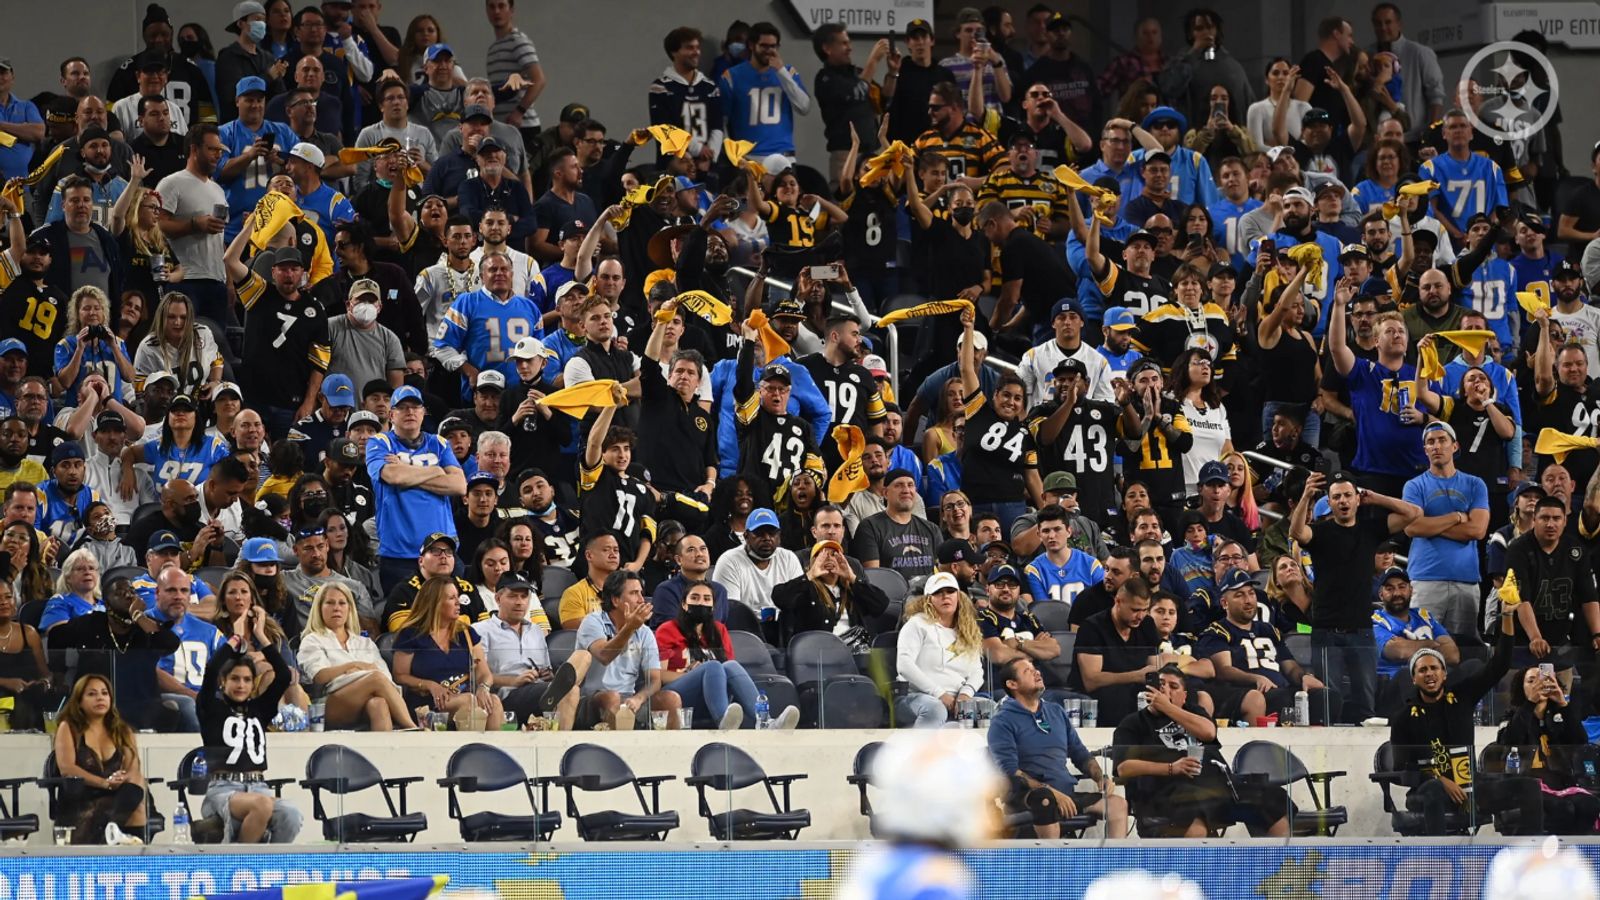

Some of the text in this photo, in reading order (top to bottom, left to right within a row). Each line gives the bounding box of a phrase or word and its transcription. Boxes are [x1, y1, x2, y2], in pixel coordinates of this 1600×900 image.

[810, 8, 896, 26] VIP ENTRY 6
[1539, 19, 1563, 35] VIP
[681, 102, 707, 144] 13
[748, 88, 781, 126] 10
[1448, 180, 1486, 218] 71
[866, 213, 882, 246] 8
[18, 297, 58, 340] 19
[1471, 280, 1505, 320] 10
[272, 312, 298, 349] 7
[486, 317, 530, 350] 19
[726, 333, 745, 351] DM
[824, 380, 858, 425] 19
[980, 421, 1023, 463] 84
[1187, 418, 1224, 431] Steelers
[761, 432, 804, 482] 43
[1063, 424, 1108, 473] 43
[1139, 427, 1173, 470] 11
[157, 460, 204, 492] 97
[173, 641, 208, 687] 10
[1240, 637, 1280, 673] 13
[222, 715, 266, 765] 90
